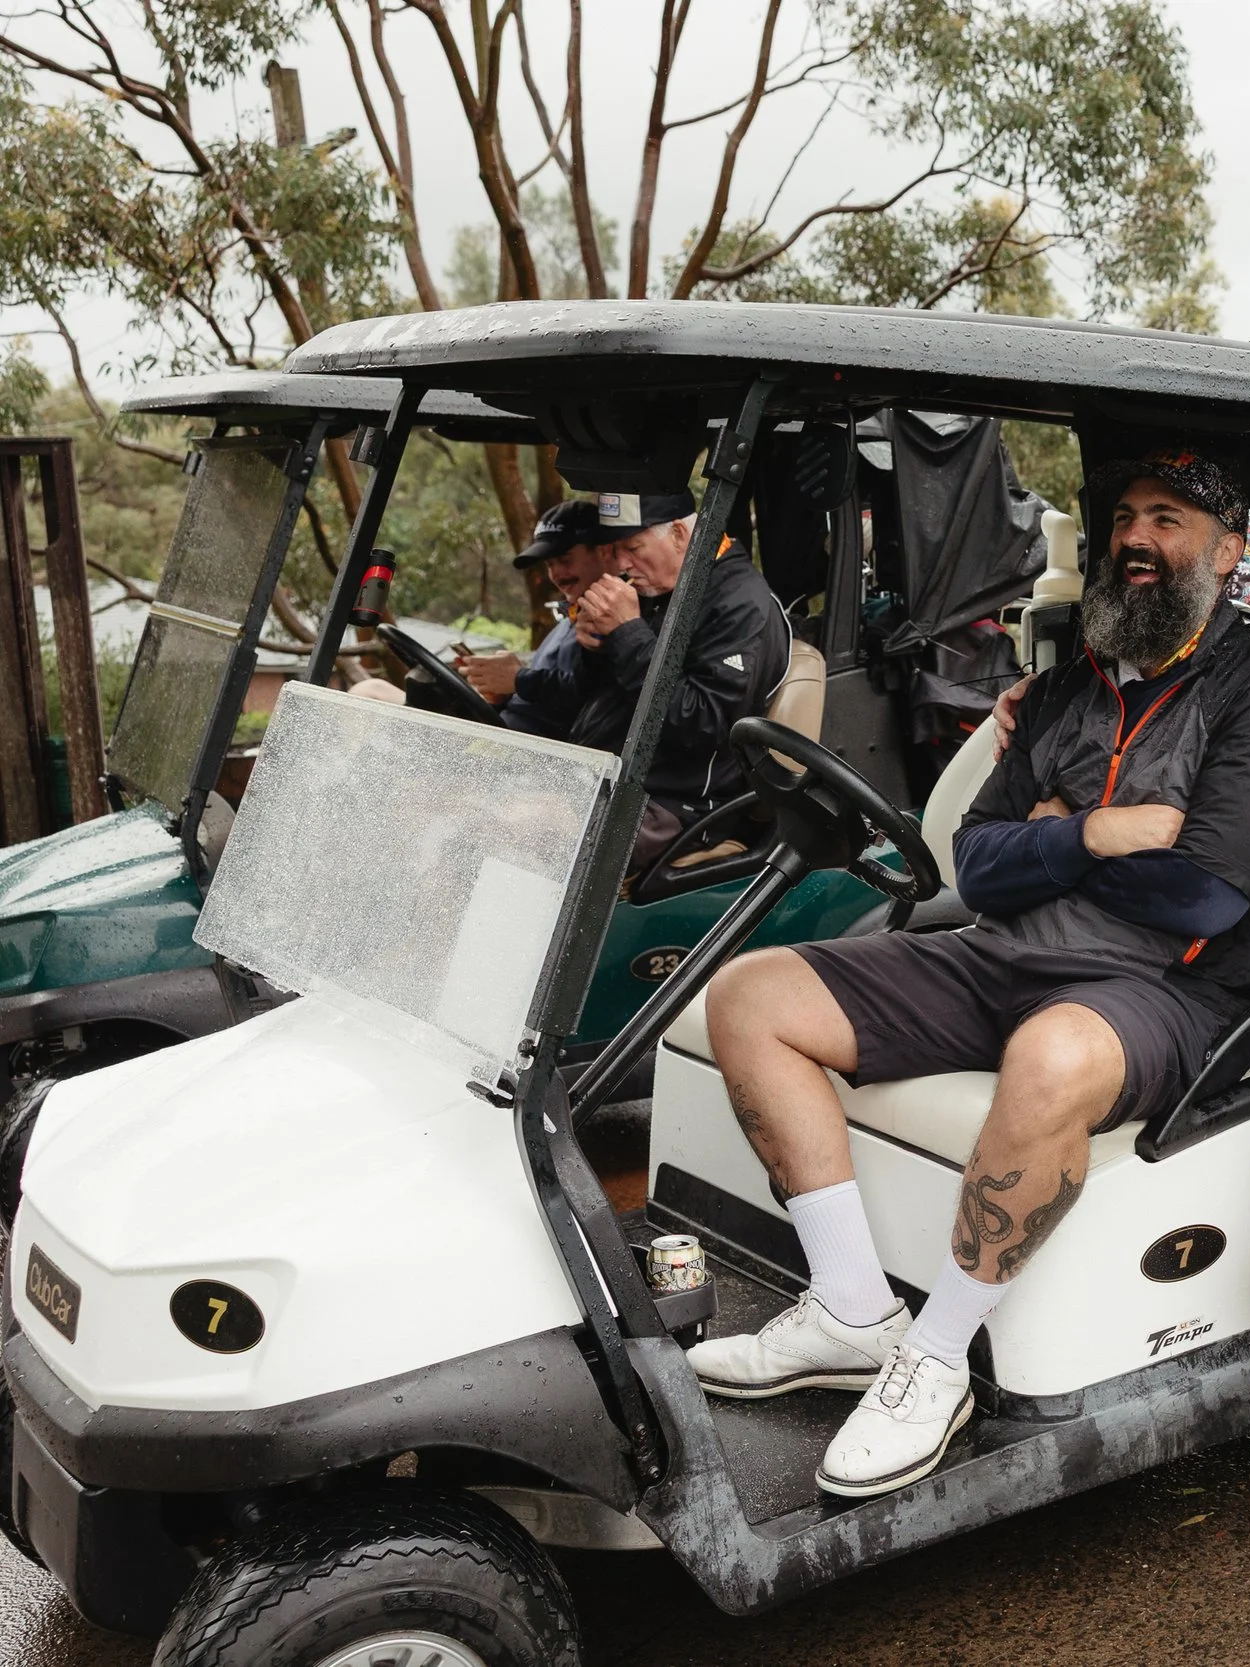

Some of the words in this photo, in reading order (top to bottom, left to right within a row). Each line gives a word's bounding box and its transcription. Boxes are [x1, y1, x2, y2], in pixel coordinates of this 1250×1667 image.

[649, 954, 680, 975] 23
[1175, 1238, 1194, 1269] 7
[30, 1262, 51, 1306] Club
[51, 1284, 71, 1325] Car
[207, 1297, 228, 1334] 7
[1146, 1322, 1214, 1357] Tempo
